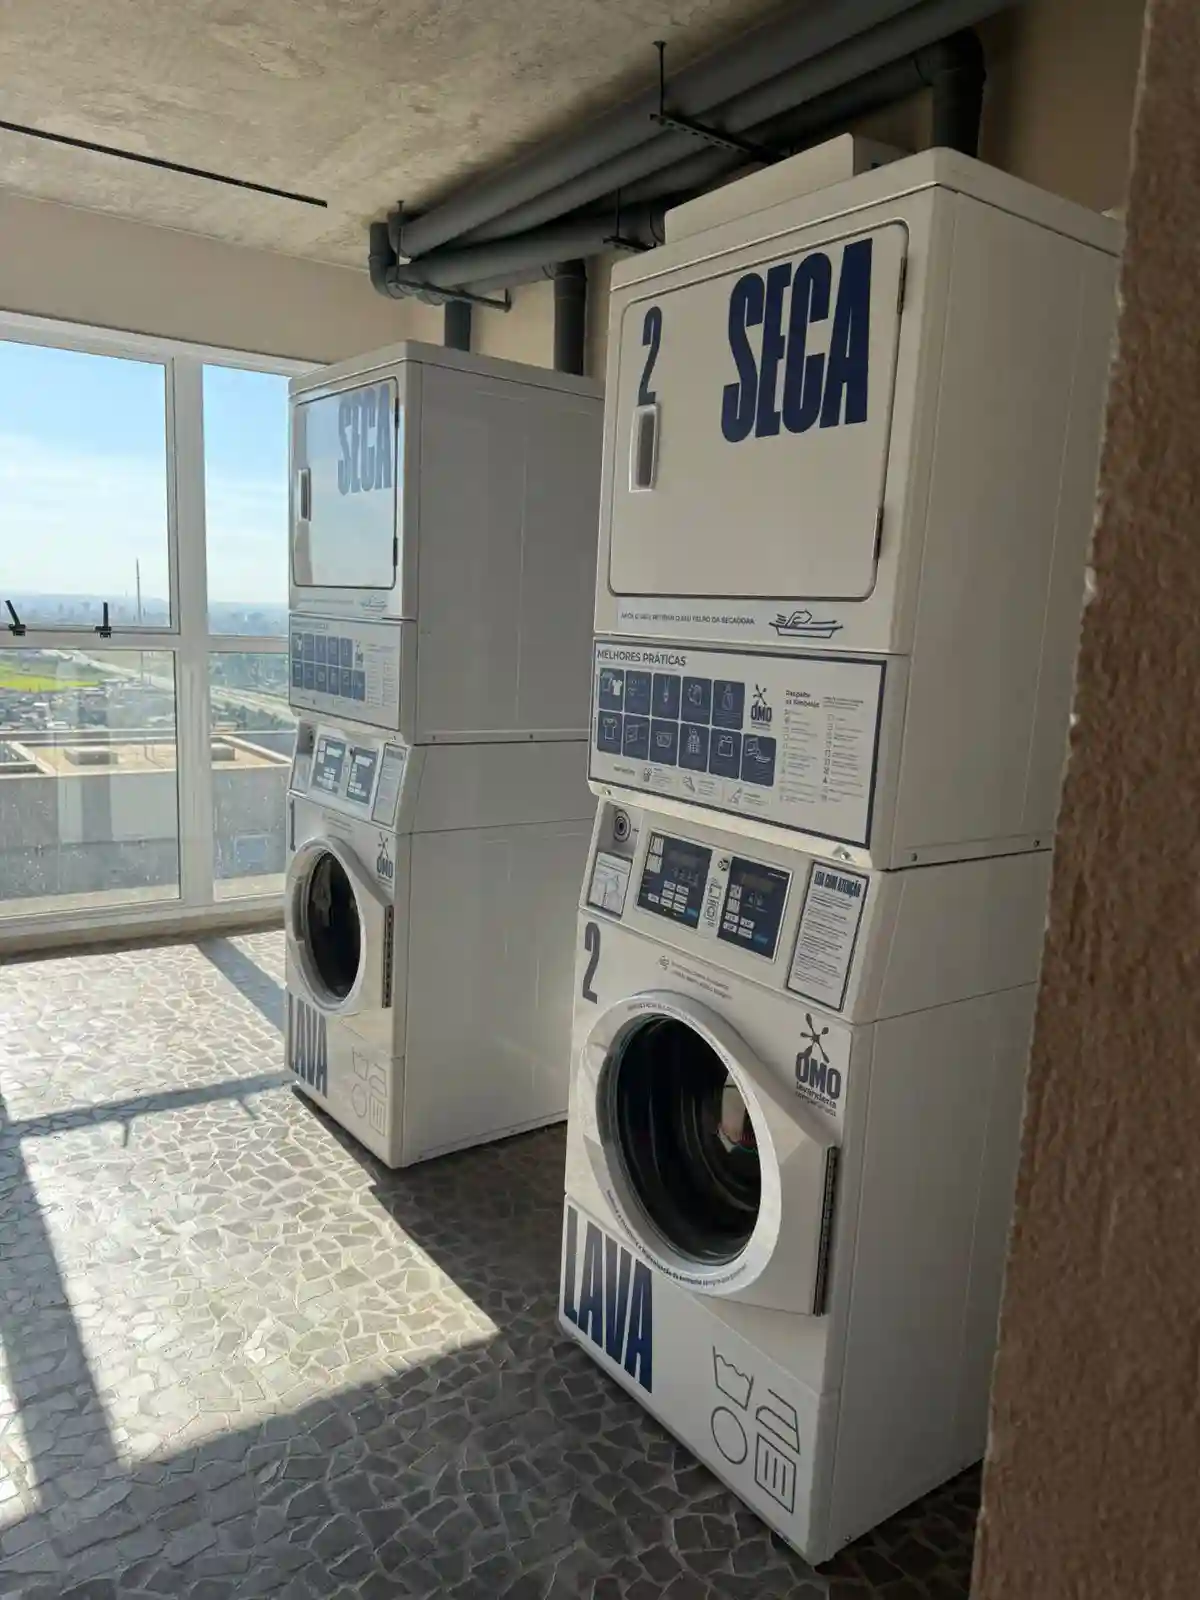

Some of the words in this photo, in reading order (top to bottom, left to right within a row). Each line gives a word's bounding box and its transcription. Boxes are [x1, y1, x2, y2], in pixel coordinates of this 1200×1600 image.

[638, 306, 662, 405] 2
[720, 238, 873, 443] SECA
[338, 384, 392, 496] SECA
[597, 649, 640, 662] MELHORES
[643, 652, 686, 666] PRÁTICAS
[751, 703, 772, 723] OMO
[582, 921, 601, 1005] 2
[289, 991, 328, 1099] LAVA
[795, 1051, 842, 1101] OMO
[563, 1205, 653, 1395] LAVA
